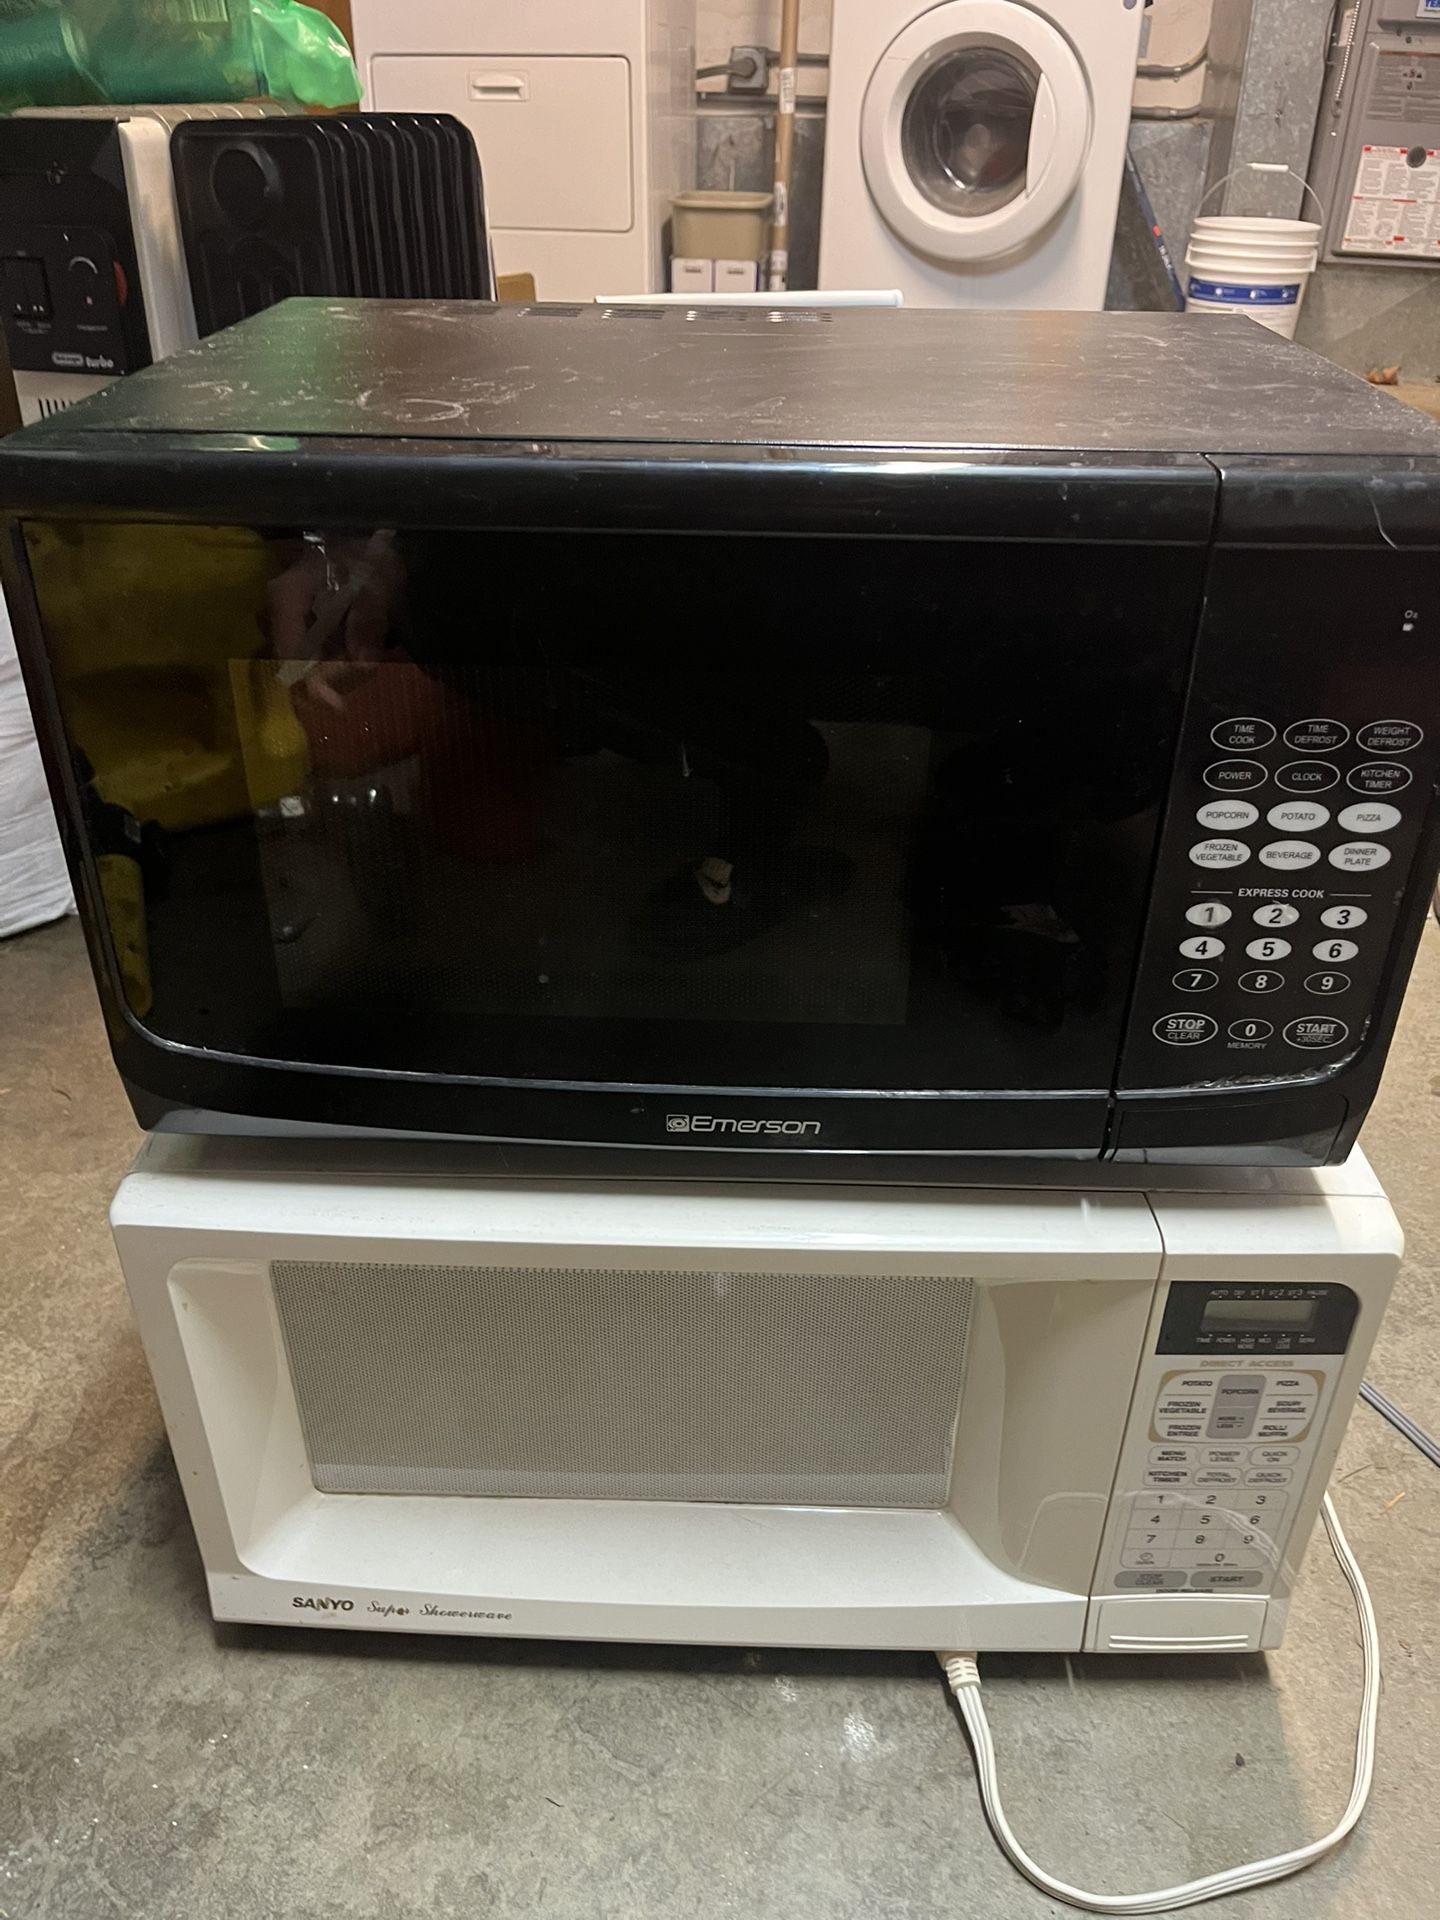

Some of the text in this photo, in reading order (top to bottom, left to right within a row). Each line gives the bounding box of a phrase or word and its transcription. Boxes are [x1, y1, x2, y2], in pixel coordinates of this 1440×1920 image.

[86, 354, 114, 368] turbo
[1234, 724, 1255, 733] TIME
[1308, 724, 1329, 733] TIME
[1373, 726, 1411, 736] WEIGHT
[1228, 735, 1256, 744] COOK
[1294, 735, 1338, 744] DEFROST
[1367, 737, 1412, 746] DEFROST
[1218, 771, 1252, 780] POWER
[1291, 772, 1322, 782] CLOCK
[1361, 770, 1401, 778] KITCHEN
[1364, 780, 1393, 789] TIMER
[1206, 810, 1250, 819] POPCORN
[1280, 812, 1316, 821] POTATO
[1356, 814, 1382, 822] PIZZA
[1204, 843, 1238, 852] FROZEN
[1344, 848, 1377, 856] DINNER
[1195, 852, 1243, 861] VEGETABLE
[1266, 850, 1313, 860] BEVERAGE
[1344, 857, 1371, 866] PLATE
[1237, 888, 1325, 899] EXPRESS COOK
[1204, 906, 1214, 922] 1
[1268, 908, 1283, 924] 2
[1336, 909, 1351, 926] 3
[1194, 940, 1208, 956] 4
[1262, 942, 1276, 957] 5
[1328, 942, 1342, 958] 6
[1190, 974, 1202, 988] 7
[1255, 975, 1268, 988] 8
[1320, 976, 1334, 990] 9
[1166, 1019, 1206, 1030] STOP
[1296, 1023, 1337, 1034] START
[1167, 1032, 1200, 1040] CLEAR
[1227, 1041, 1266, 1050] MEMORY
[691, 1115, 821, 1134] Emerson
[1200, 1360, 1244, 1368] DIRECT
[1205, 1495, 1216, 1505] 2
[1256, 1496, 1266, 1505] 3
[1150, 1515, 1160, 1524] 4
[1200, 1515, 1211, 1525] 5
[1250, 1515, 1260, 1525] 6
[1146, 1535, 1157, 1544] 7
[1195, 1535, 1205, 1544] 8
[1214, 1553, 1225, 1562] 0
[292, 1597, 354, 1611] SANYO
[419, 1603, 513, 1620] Showerwave
